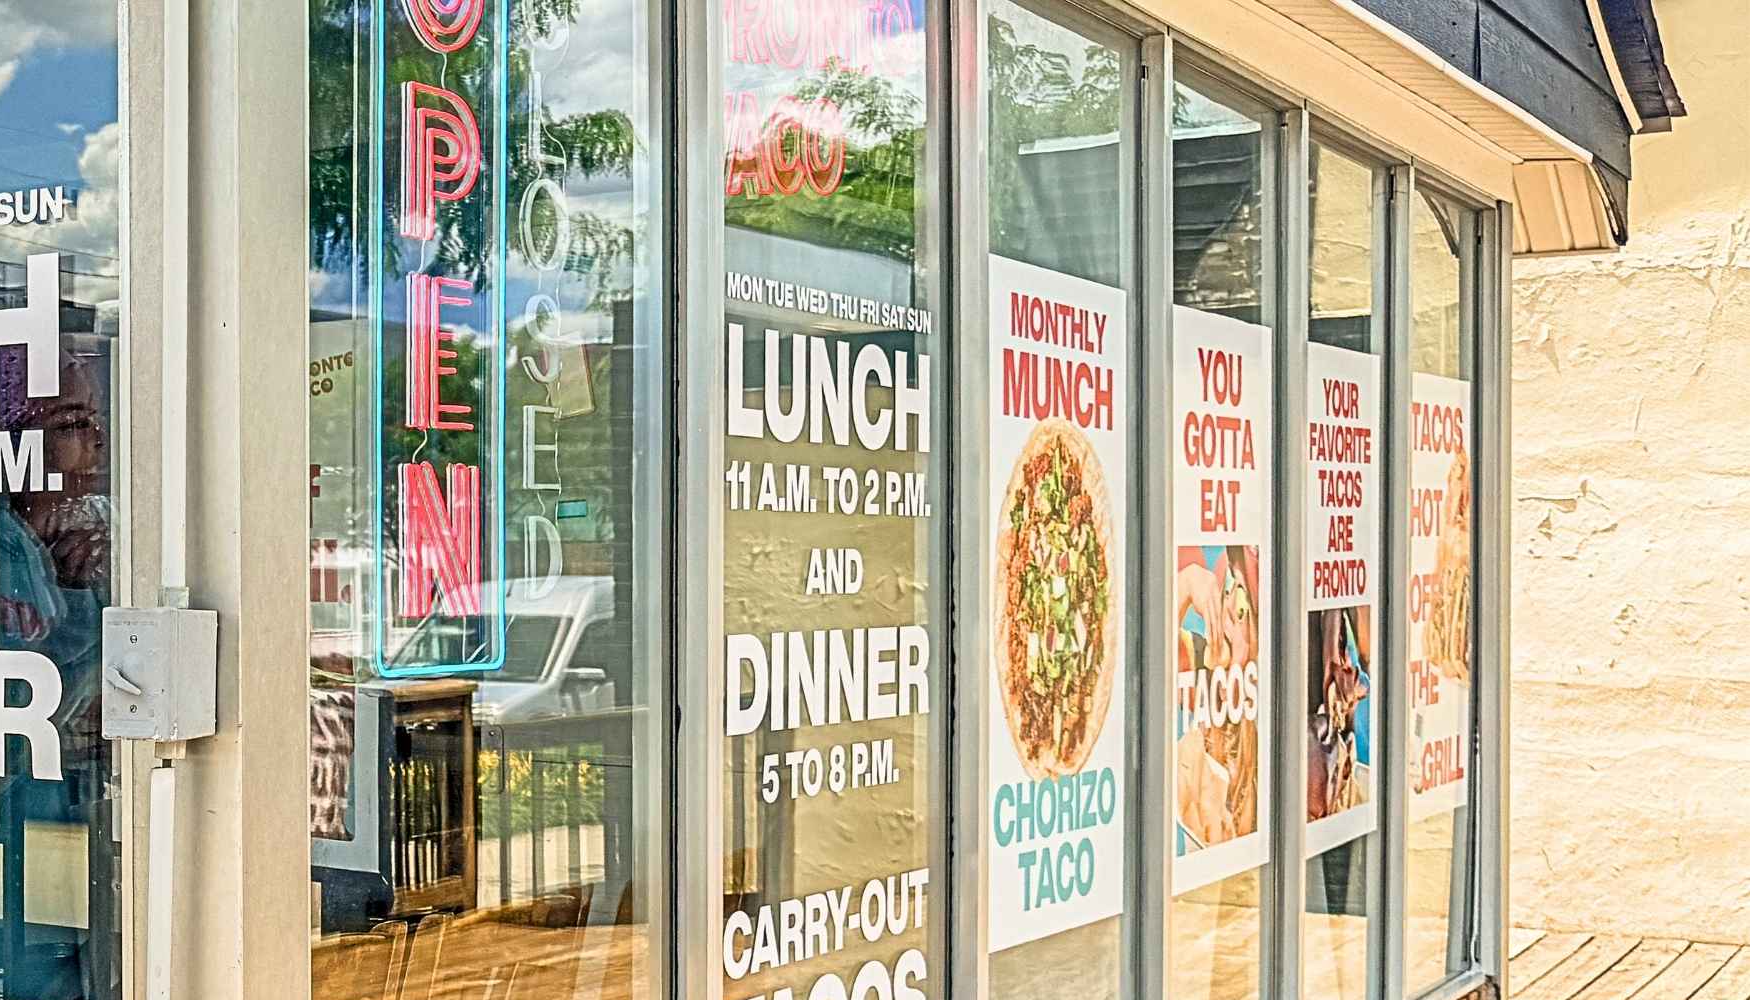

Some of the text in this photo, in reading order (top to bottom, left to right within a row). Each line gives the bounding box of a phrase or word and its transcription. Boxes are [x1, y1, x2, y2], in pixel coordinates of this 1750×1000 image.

[727, 271, 932, 334] MON TUE WED THU FRI SAT SUN
[1010, 291, 1108, 354] MONTHLY
[727, 322, 931, 452] LUNCH
[1002, 349, 1113, 431] MUNCH
[1197, 347, 1242, 406] YOU
[1322, 377, 1359, 420] YOUR
[1183, 412, 1255, 470] GOTTA
[1308, 422, 1371, 465] FAVORITE
[1410, 402, 1464, 454] TACOS
[725, 461, 931, 517] 11 A.M. TO 2 P.M.
[1200, 479, 1240, 532] EAT
[1317, 470, 1362, 510] TACOS
[1410, 487, 1443, 538] HOT
[1326, 515, 1353, 553] ARE
[805, 547, 863, 595] AND
[1313, 559, 1367, 599] PRONTO
[725, 625, 930, 737] DINNER
[1177, 660, 1258, 734] TACOS
[1410, 660, 1439, 709] THE
[762, 738, 900, 804] 5 TO 8 P.M.
[1421, 734, 1465, 793] GRILL
[994, 766, 1116, 848] CHORIZO
[1018, 838, 1095, 912] TACO
[723, 868, 929, 980] CARRY-OUT
